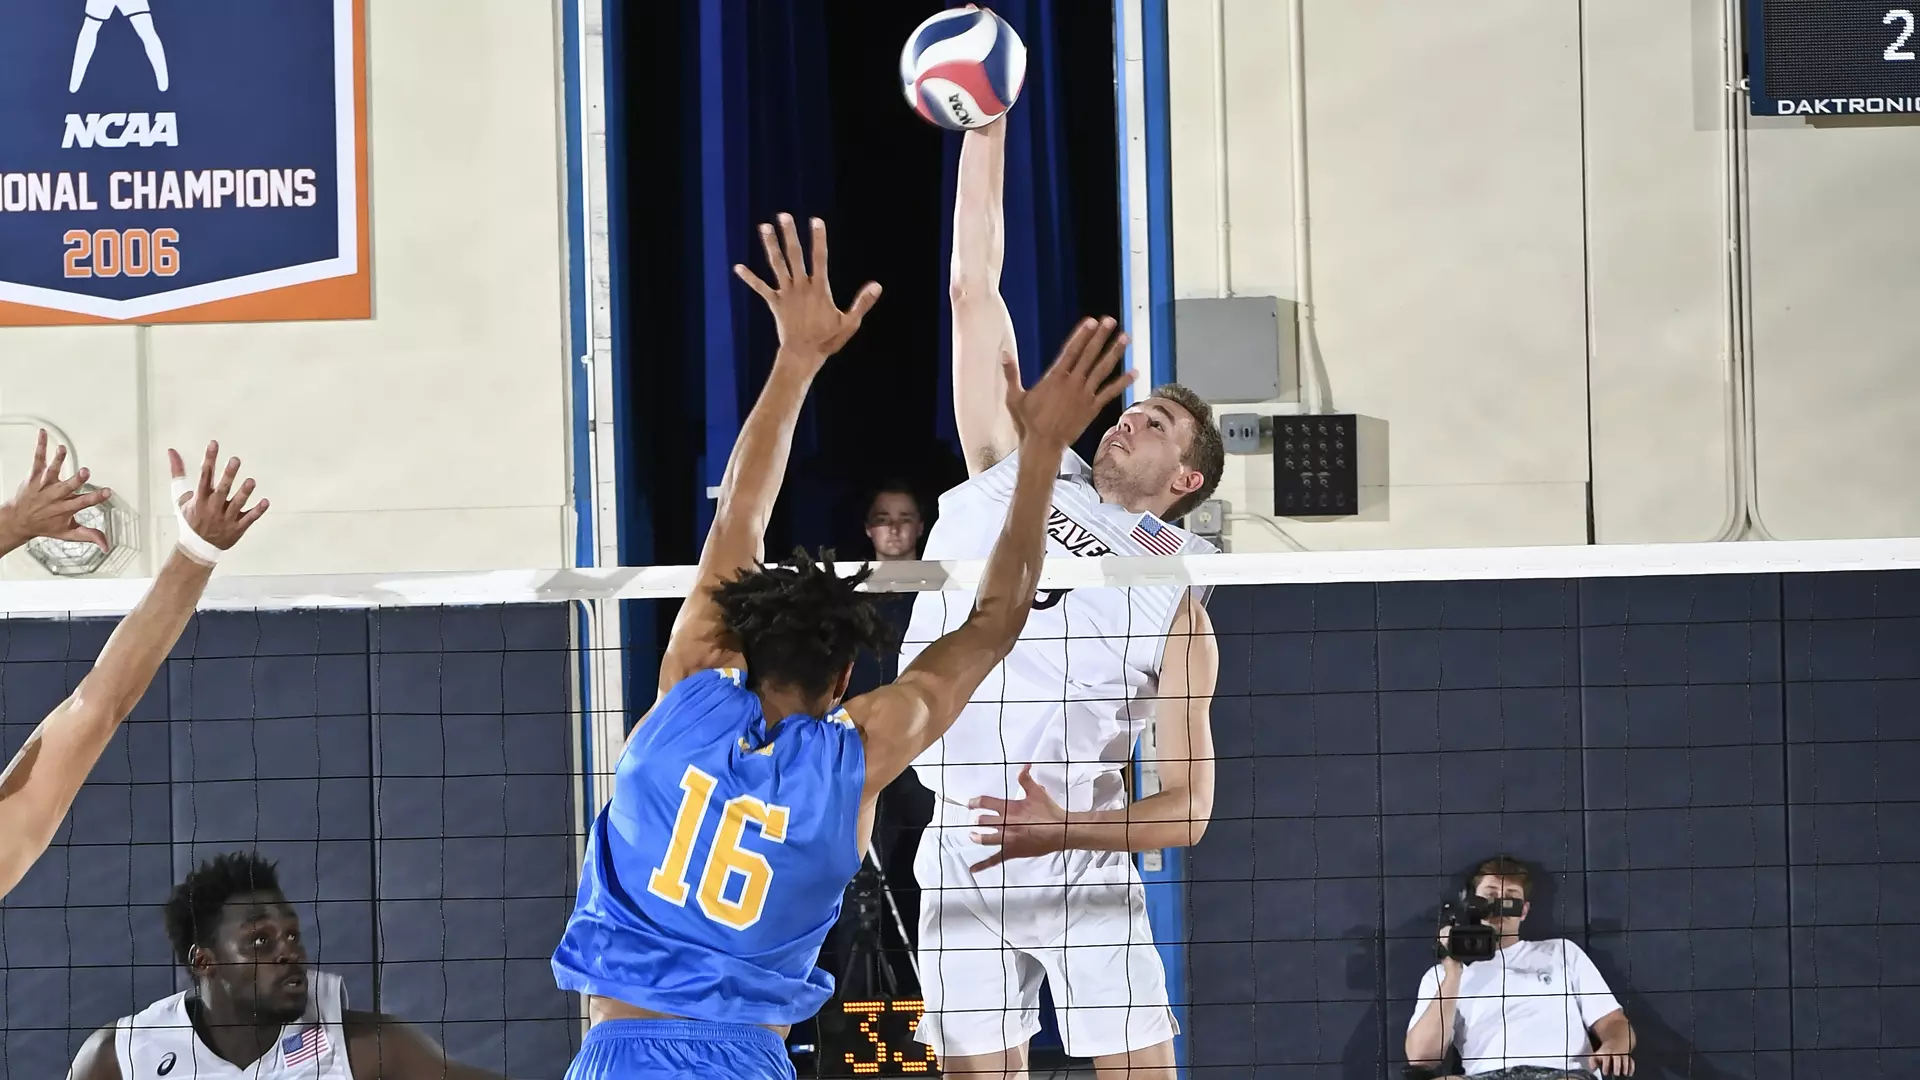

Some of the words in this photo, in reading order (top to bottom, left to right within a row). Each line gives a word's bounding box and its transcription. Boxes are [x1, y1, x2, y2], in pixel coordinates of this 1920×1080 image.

[1883, 9, 1916, 61] 2
[61, 112, 178, 148] NCAA
[109, 169, 316, 210] CHAMPIONS
[63, 228, 180, 278] 2006
[1047, 504, 1119, 557] AVE
[647, 764, 790, 931] 16
